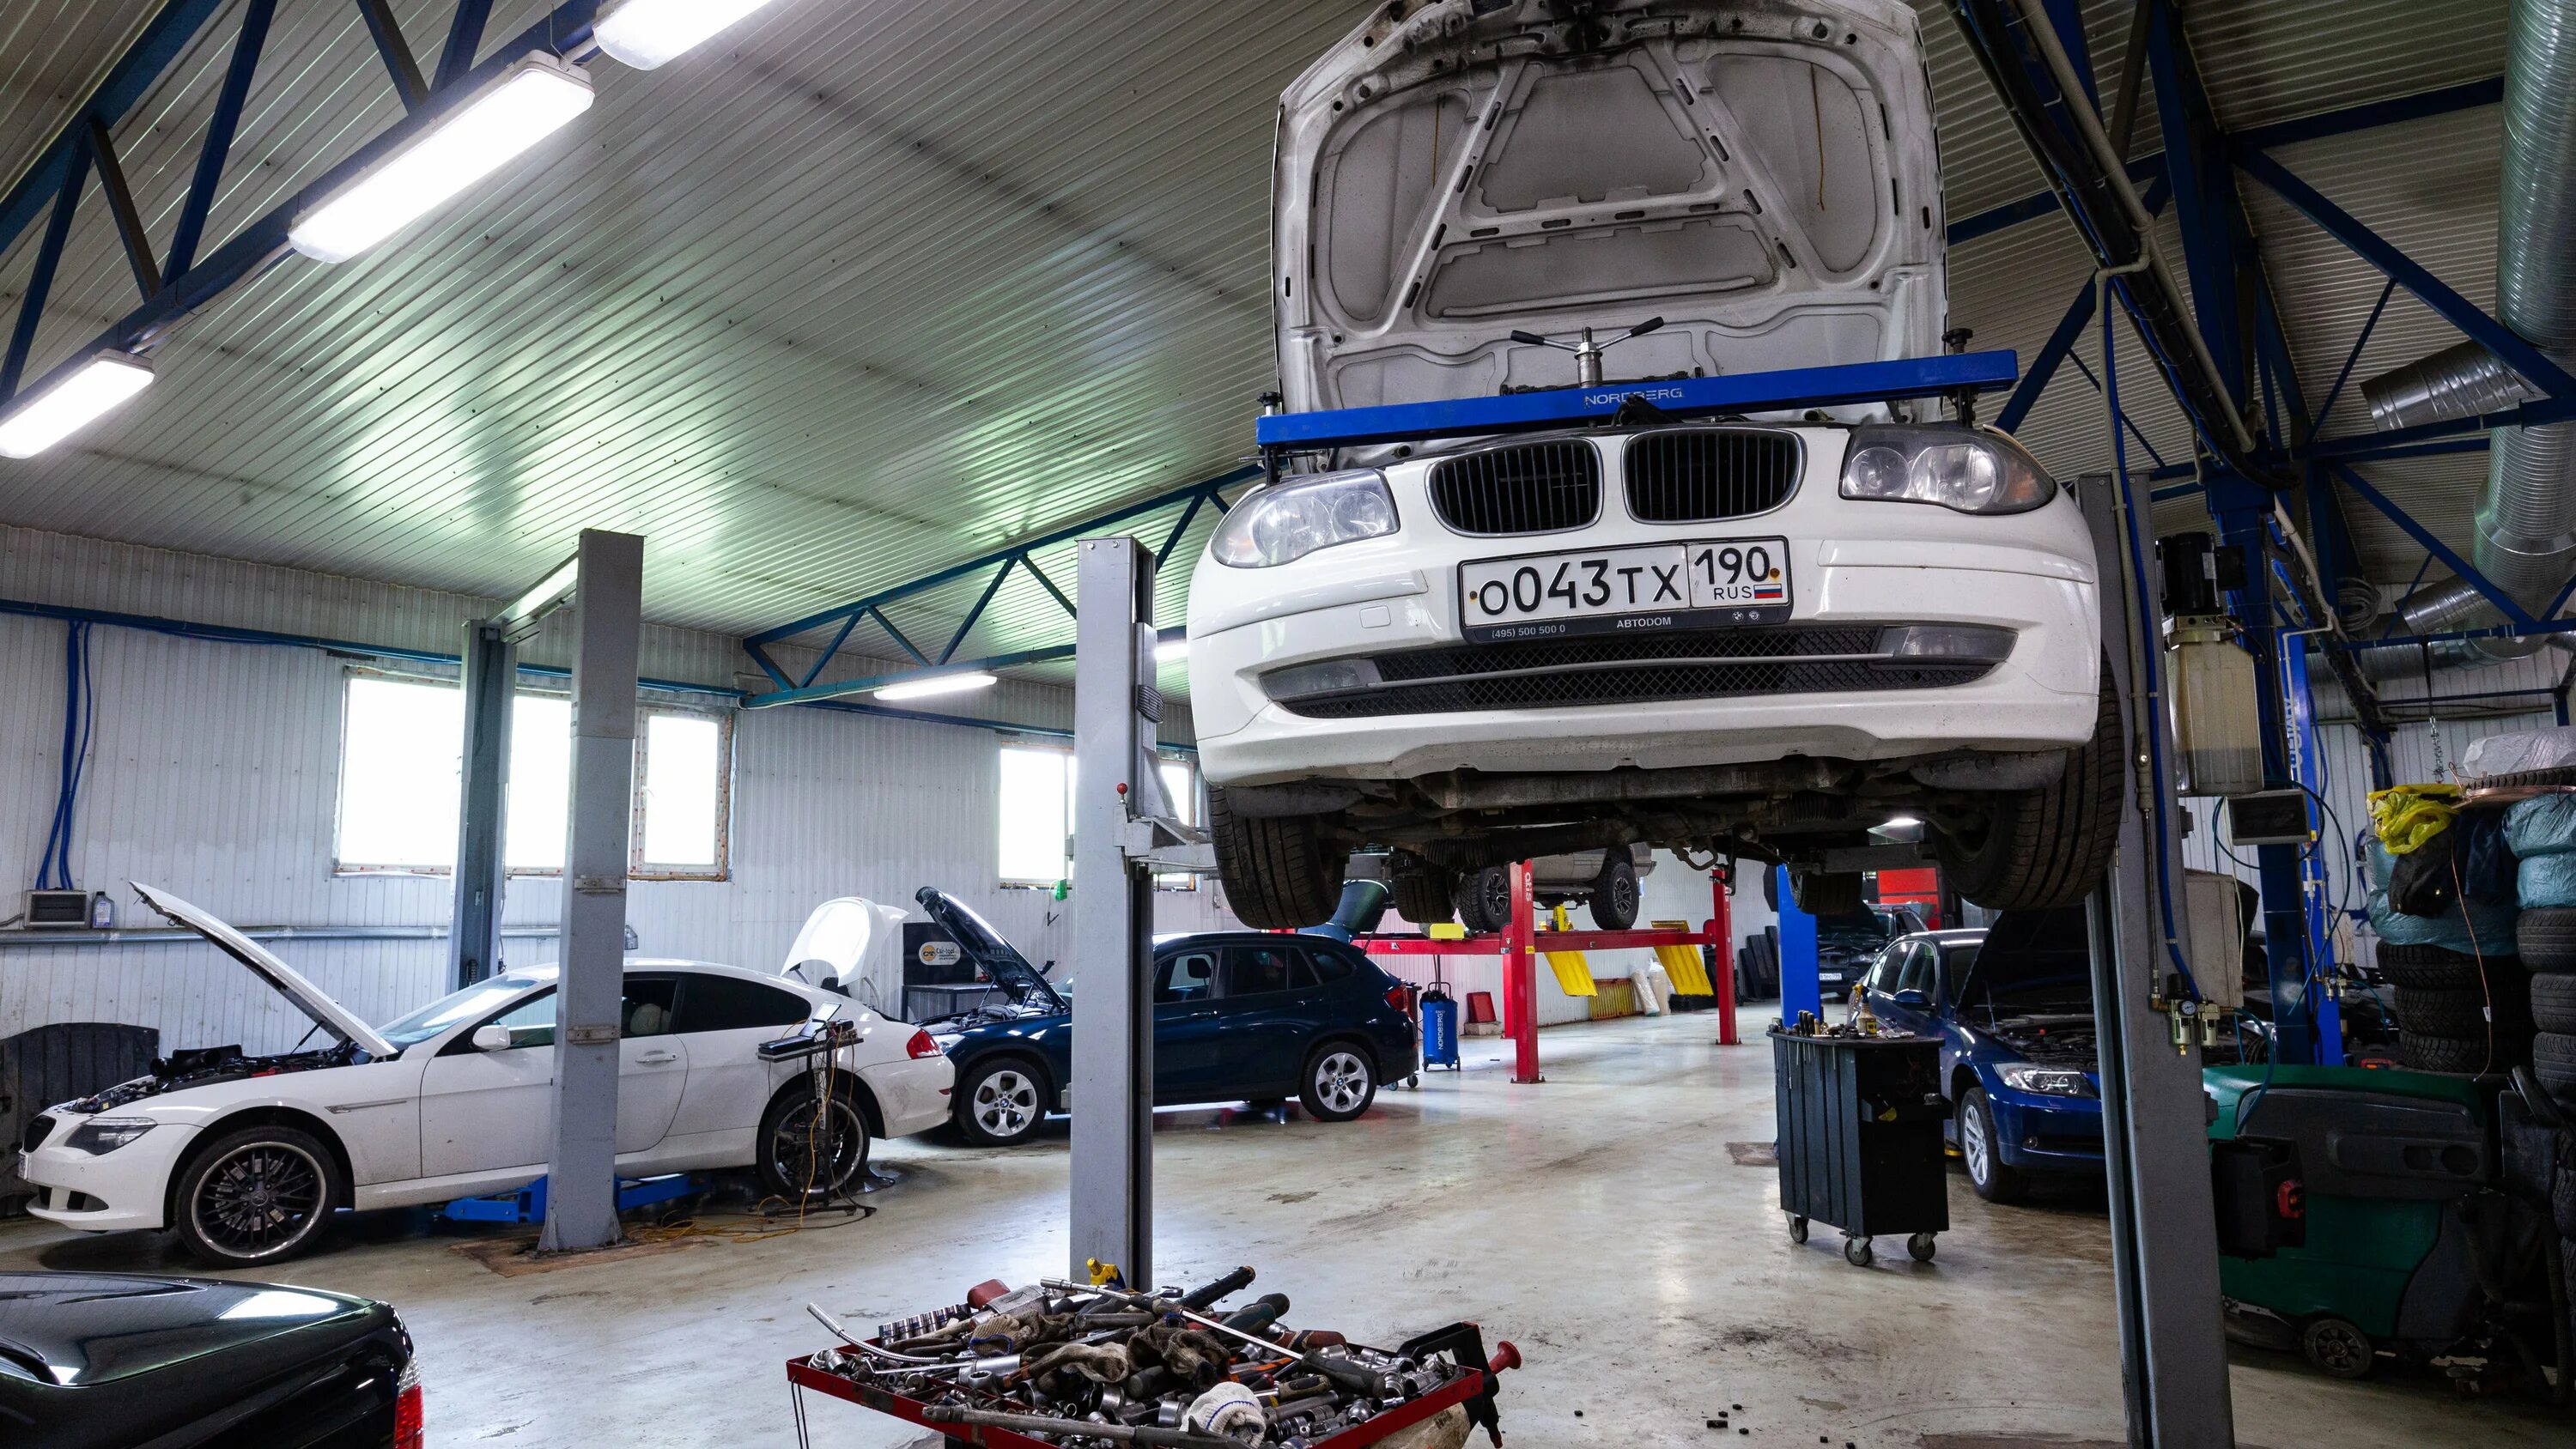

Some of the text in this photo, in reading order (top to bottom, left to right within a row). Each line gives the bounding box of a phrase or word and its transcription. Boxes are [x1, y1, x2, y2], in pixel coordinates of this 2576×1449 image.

[1694, 546, 1771, 585] 190
[1714, 585, 1753, 600] RUS
[1492, 624, 1565, 639] (495) 500 500 0
